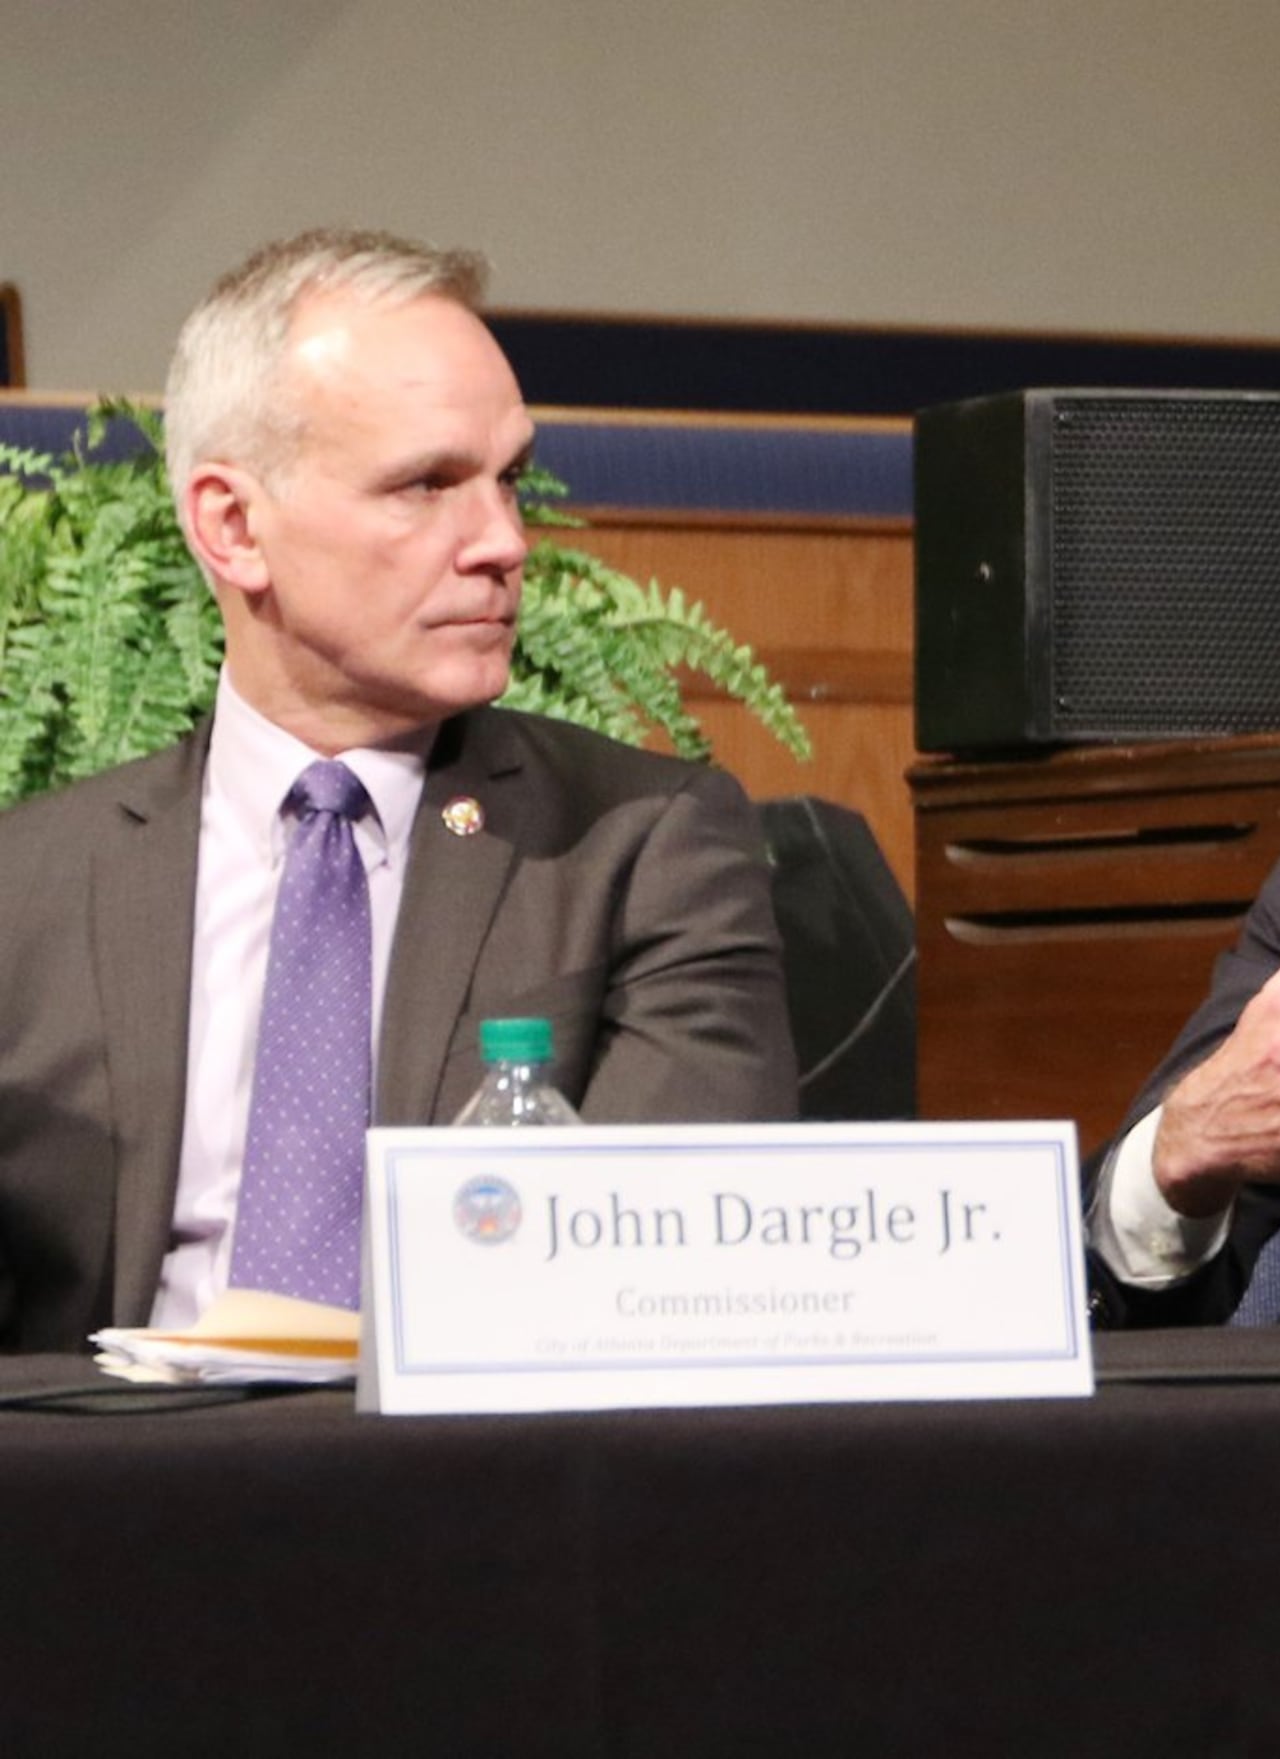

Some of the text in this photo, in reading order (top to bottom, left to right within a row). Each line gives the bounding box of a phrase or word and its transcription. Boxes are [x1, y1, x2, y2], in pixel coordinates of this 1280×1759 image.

[546, 1188, 1002, 1262] John Dargle Jr.
[614, 1287, 856, 1318] Commissioner
